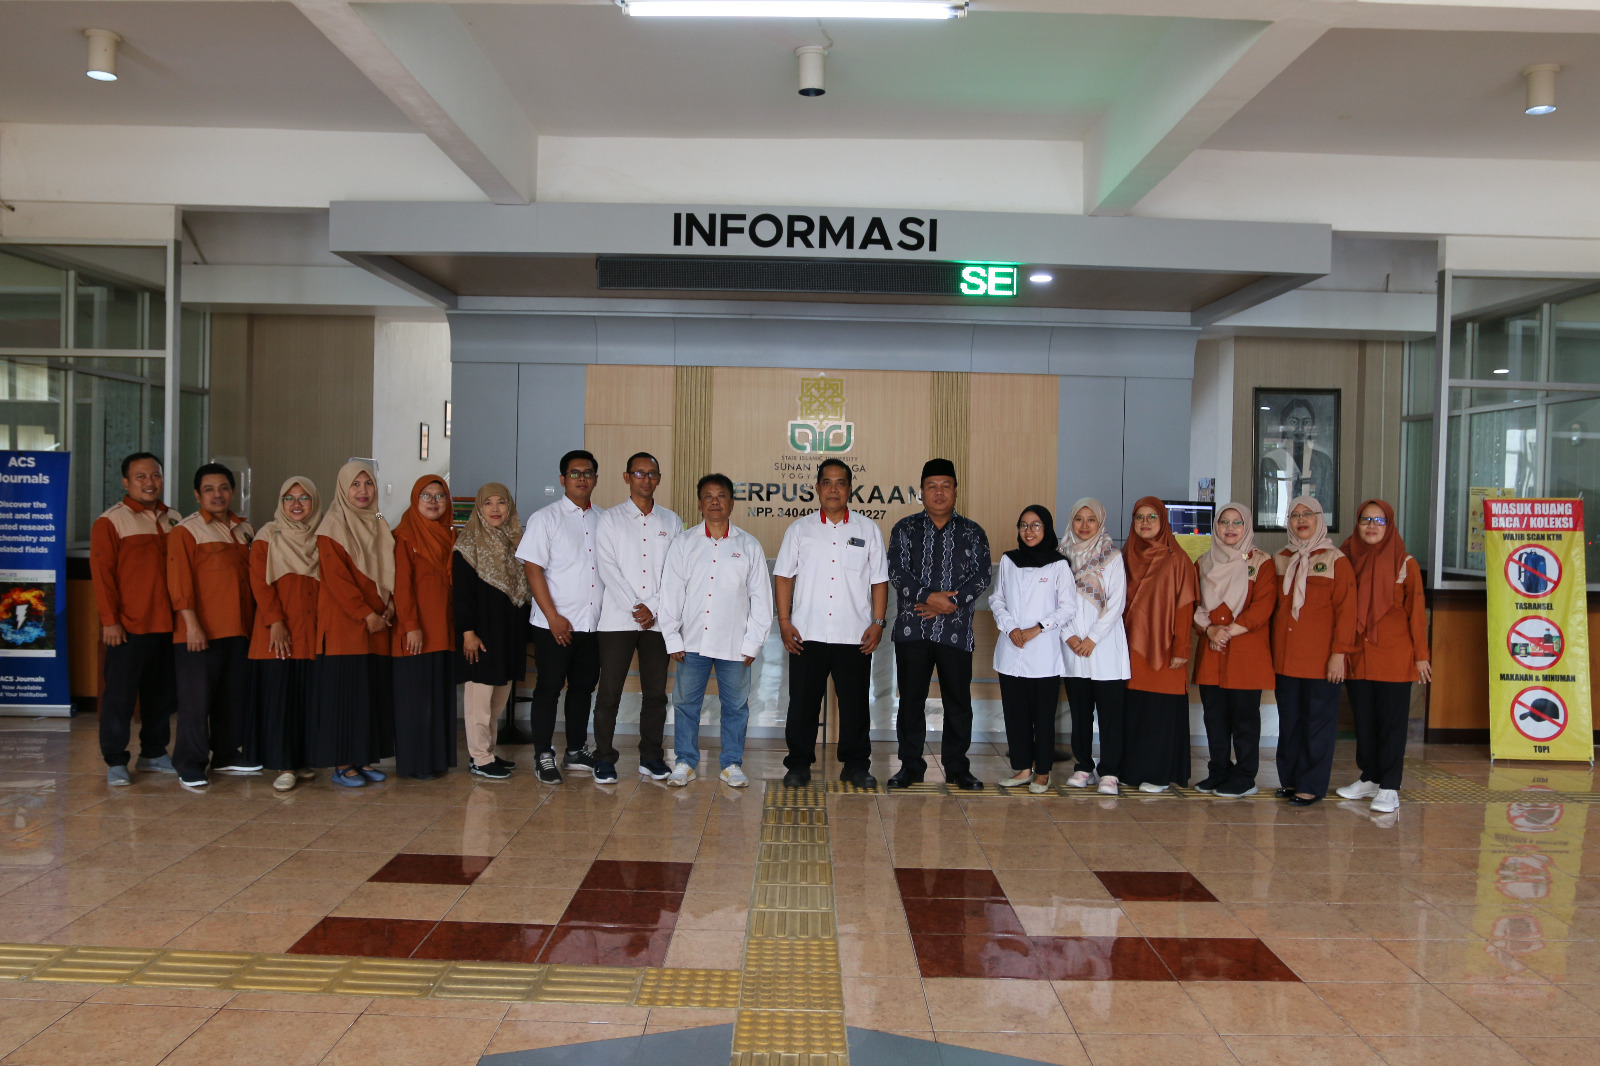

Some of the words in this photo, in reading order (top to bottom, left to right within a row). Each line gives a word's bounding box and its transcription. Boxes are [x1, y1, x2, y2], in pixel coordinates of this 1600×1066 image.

[673, 212, 938, 252] INFORMASI
[960, 266, 1017, 296] SE
[8, 456, 36, 468] ACS
[774, 462, 811, 471] SUNAN
[732, 482, 924, 504] ERPUSKAAN
[33, 501, 47, 509] the
[1491, 502, 1532, 515] MASUK
[1534, 503, 1573, 515] RUANG
[14, 512, 31, 520] and
[31, 512, 53, 520] most
[747, 507, 775, 517] NPP.
[19, 523, 55, 531] research
[1491, 516, 1520, 528] BACA
[1530, 517, 1574, 529] KOLEKSI
[1503, 533, 1525, 541] WAJIB
[1526, 533, 1545, 541] SCAN
[1546, 533, 1563, 541] KTM
[0, 545, 24, 553] elated
[25, 546, 48, 554] fields
[1500, 673, 1533, 682] MAKANAN
[1542, 674, 1576, 682] MINUMAN
[1533, 745, 1550, 753] TOPI
